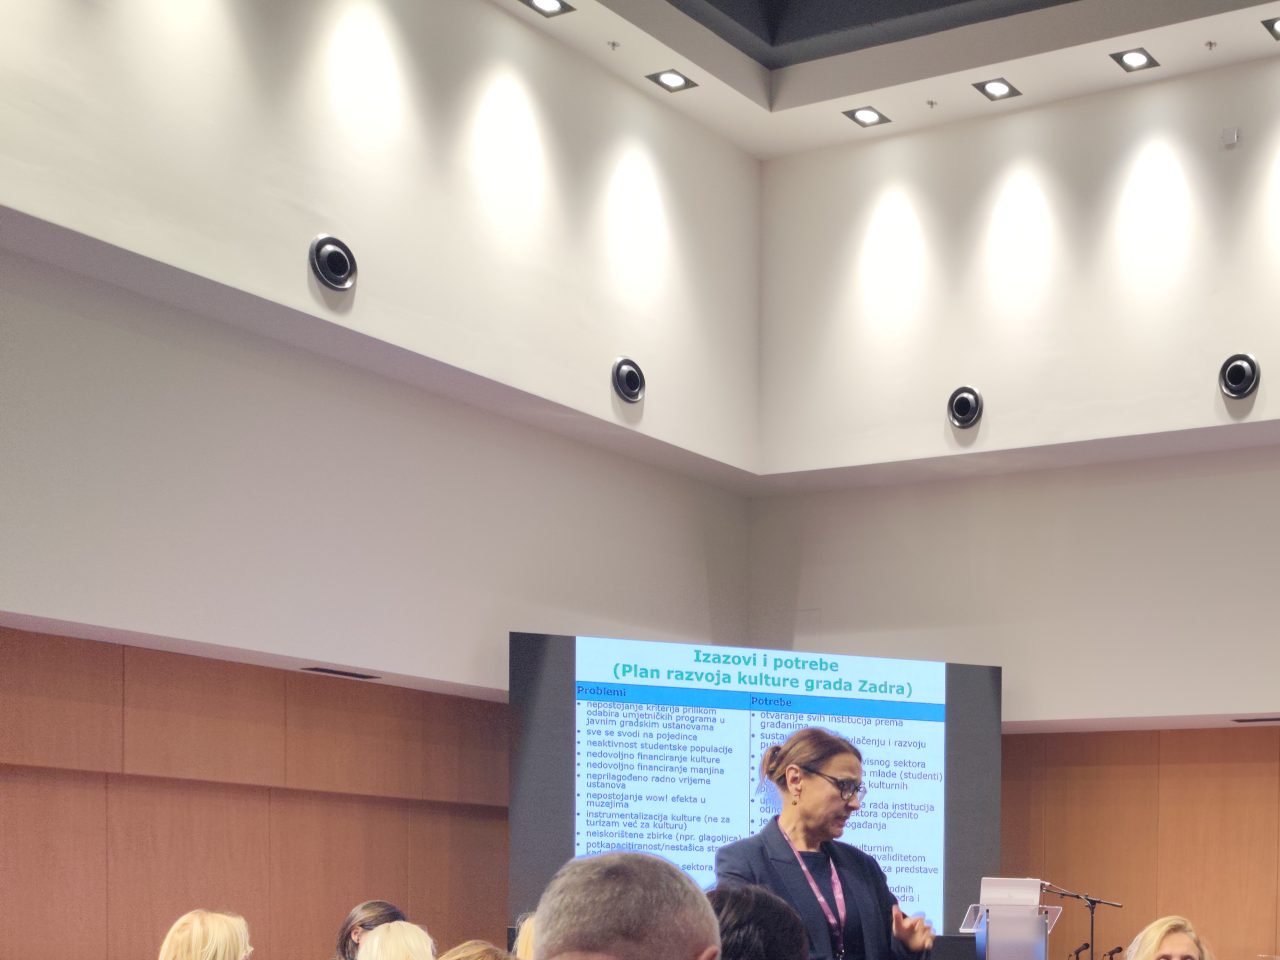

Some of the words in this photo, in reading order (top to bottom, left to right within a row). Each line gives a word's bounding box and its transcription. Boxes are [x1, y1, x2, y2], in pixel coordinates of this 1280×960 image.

[694, 650, 757, 667] Izazovi
[763, 655, 767, 667] i
[774, 656, 839, 672] potrebe
[613, 663, 660, 680] (Plan
[667, 669, 731, 685] razvoja
[738, 671, 799, 688] kulture
[805, 675, 852, 692] grada
[858, 680, 913, 698] Zadra)
[577, 685, 626, 697] Problemi
[587, 701, 644, 712] nepostojanje
[646, 703, 680, 714] kriterija
[683, 706, 717, 716] prilikom
[752, 698, 792, 707] Potrebe
[587, 709, 619, 718] odabira
[623, 711, 673, 722] umjetničkih
[676, 715, 716, 725] programa
[760, 712, 804, 721] otvaranje
[807, 713, 825, 722] svih
[828, 715, 871, 725] institucija
[875, 719, 903, 728] prema
[586, 718, 616, 726] javnim
[620, 719, 659, 728] gradskim
[663, 722, 714, 731] ustanovama
[617, 729, 640, 738] svodi
[657, 731, 697, 741] pojedince
[587, 740, 637, 749] neaktivnost
[640, 743, 687, 751] studentske
[690, 745, 732, 754] populacije
[894, 740, 926, 749] razvoju
[587, 751, 634, 760] nedovoljno
[637, 752, 687, 763] financiranje
[691, 755, 720, 764] kulture
[587, 762, 634, 771] nedovoljno
[637, 763, 687, 774] financiranje
[691, 767, 725, 775] manjina
[893, 760, 926, 768] sektora
[587, 772, 648, 783] neprilagođeno
[651, 775, 675, 783] radno
[679, 777, 711, 785] vrijeme
[870, 770, 896, 778] mlade
[899, 772, 942, 781] (studenti)
[868, 781, 908, 790] kulturnih
[587, 792, 643, 802] nepostojanje
[646, 794, 667, 802] wow!
[671, 795, 698, 804] efekta
[587, 801, 629, 809] muzejima
[869, 802, 889, 810] rada
[892, 802, 935, 812] institucija
[587, 811, 668, 822] instrumentalizacija
[671, 814, 700, 822] kulture
[704, 815, 718, 824] (ne
[881, 810, 918, 820] općenito
[623, 820, 637, 828] već
[653, 821, 687, 831] kulturu)
[846, 820, 887, 830] ogađanja
[586, 830, 644, 839] neiskorištene
[647, 832, 673, 840] zbirke
[676, 833, 695, 841] (npr.
[699, 834, 742, 843] glagoljica)
[895, 866, 938, 875] predstave
